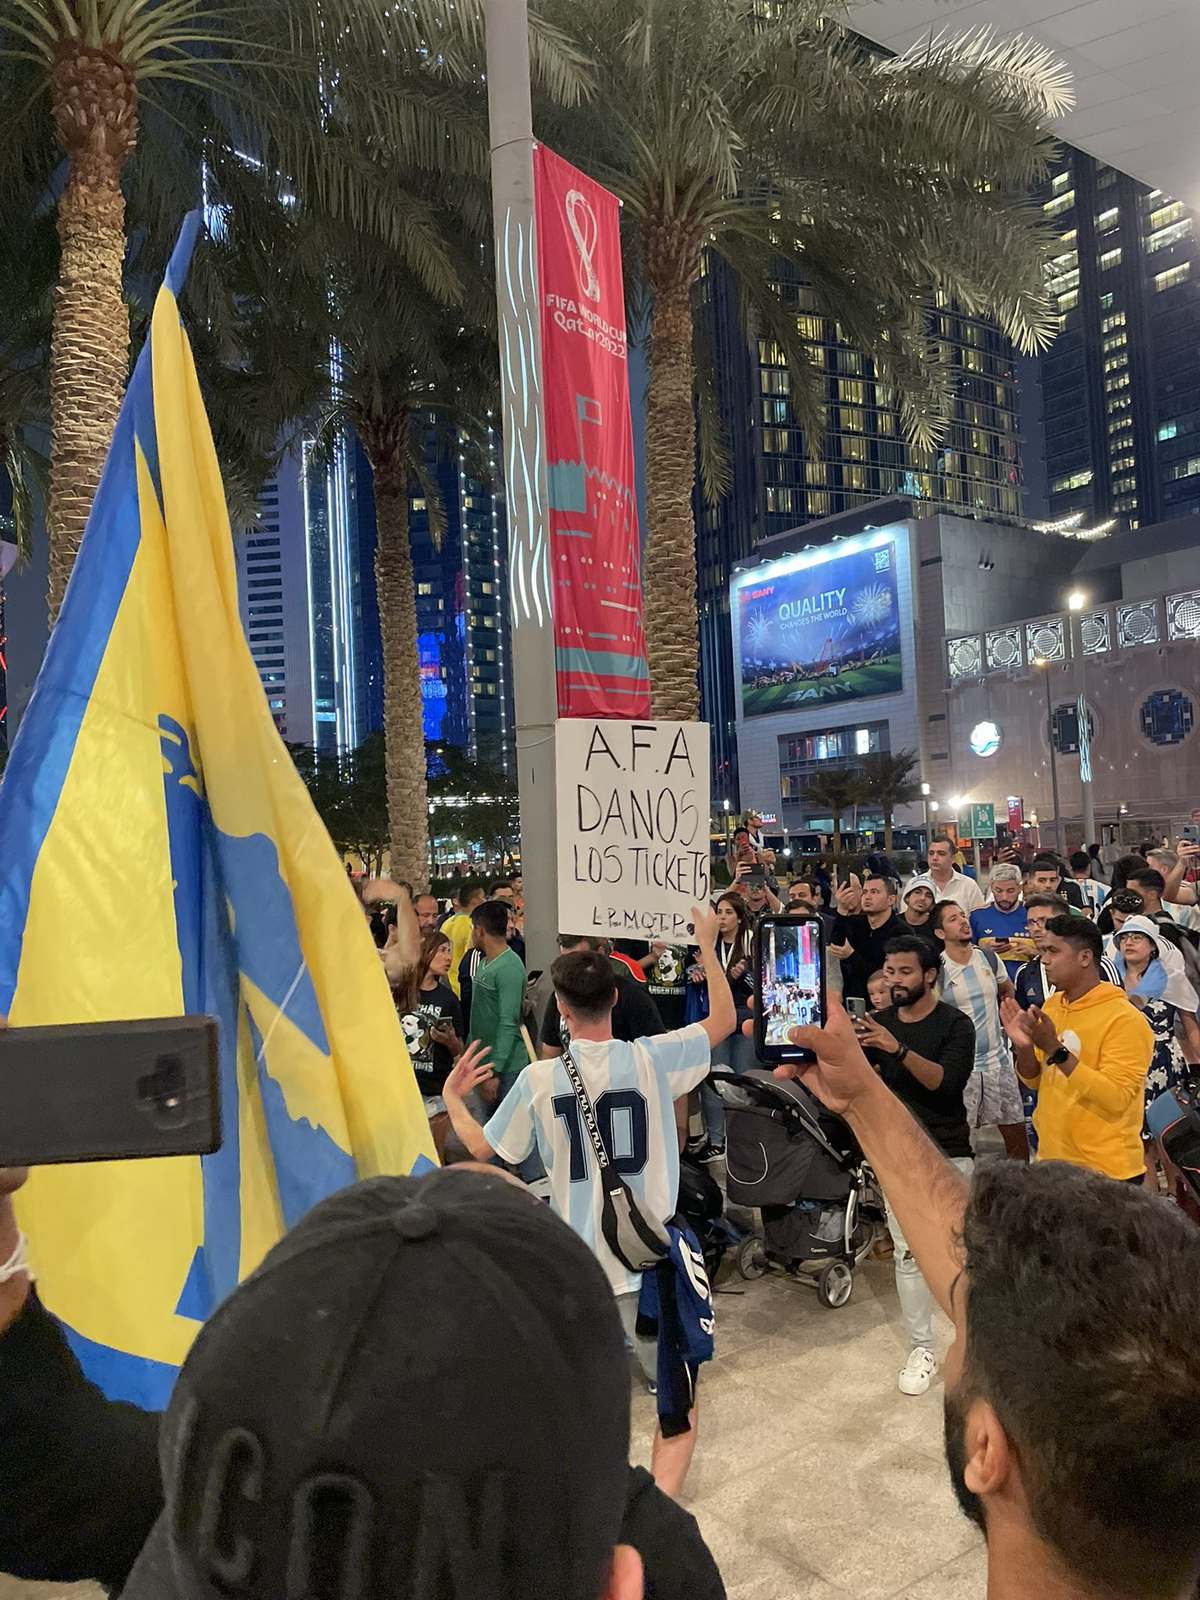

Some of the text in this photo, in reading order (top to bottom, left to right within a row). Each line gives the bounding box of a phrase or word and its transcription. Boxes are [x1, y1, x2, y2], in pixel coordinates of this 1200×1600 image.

[546, 294, 577, 314] FIFA
[578, 302, 609, 334] WORLD
[779, 587, 847, 620] QUALITY
[780, 607, 848, 631] CHANGES THE WORLD
[781, 681, 852, 704] SANY
[577, 784, 699, 847] DANOS
[573, 844, 623, 883] LOS
[551, 1088, 650, 1182] 10
